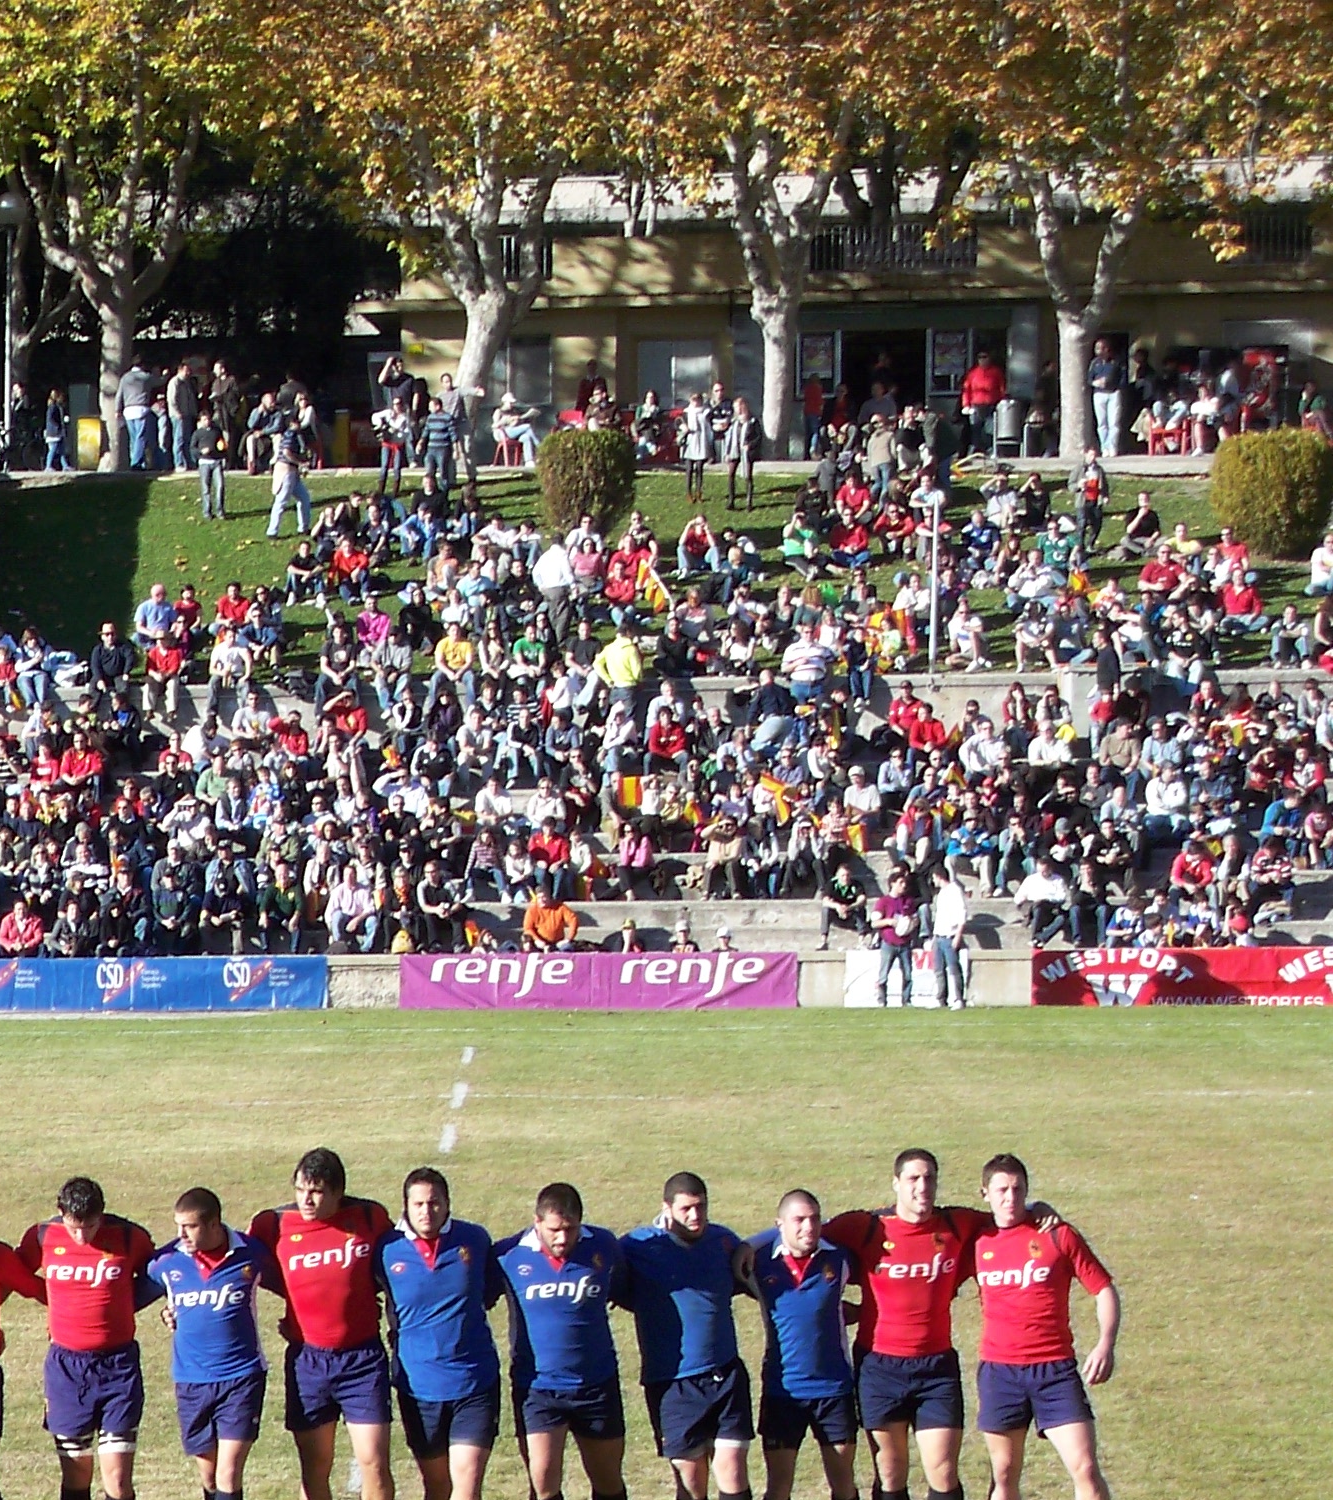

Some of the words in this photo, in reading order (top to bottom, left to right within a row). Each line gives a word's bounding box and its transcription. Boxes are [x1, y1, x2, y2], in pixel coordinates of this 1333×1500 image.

[96, 963, 124, 989] CSD
[223, 962, 251, 988] CSD
[429, 952, 574, 998] renfe
[619, 951, 766, 997] renfe
[1040, 948, 1195, 984] WESTPORT
[288, 1238, 370, 1271] renfe
[874, 1251, 956, 1284] renfe
[45, 1258, 121, 1288] renfe
[976, 1258, 1051, 1289] renfe
[174, 1283, 245, 1311] renfe
[525, 1275, 601, 1303] renfe
